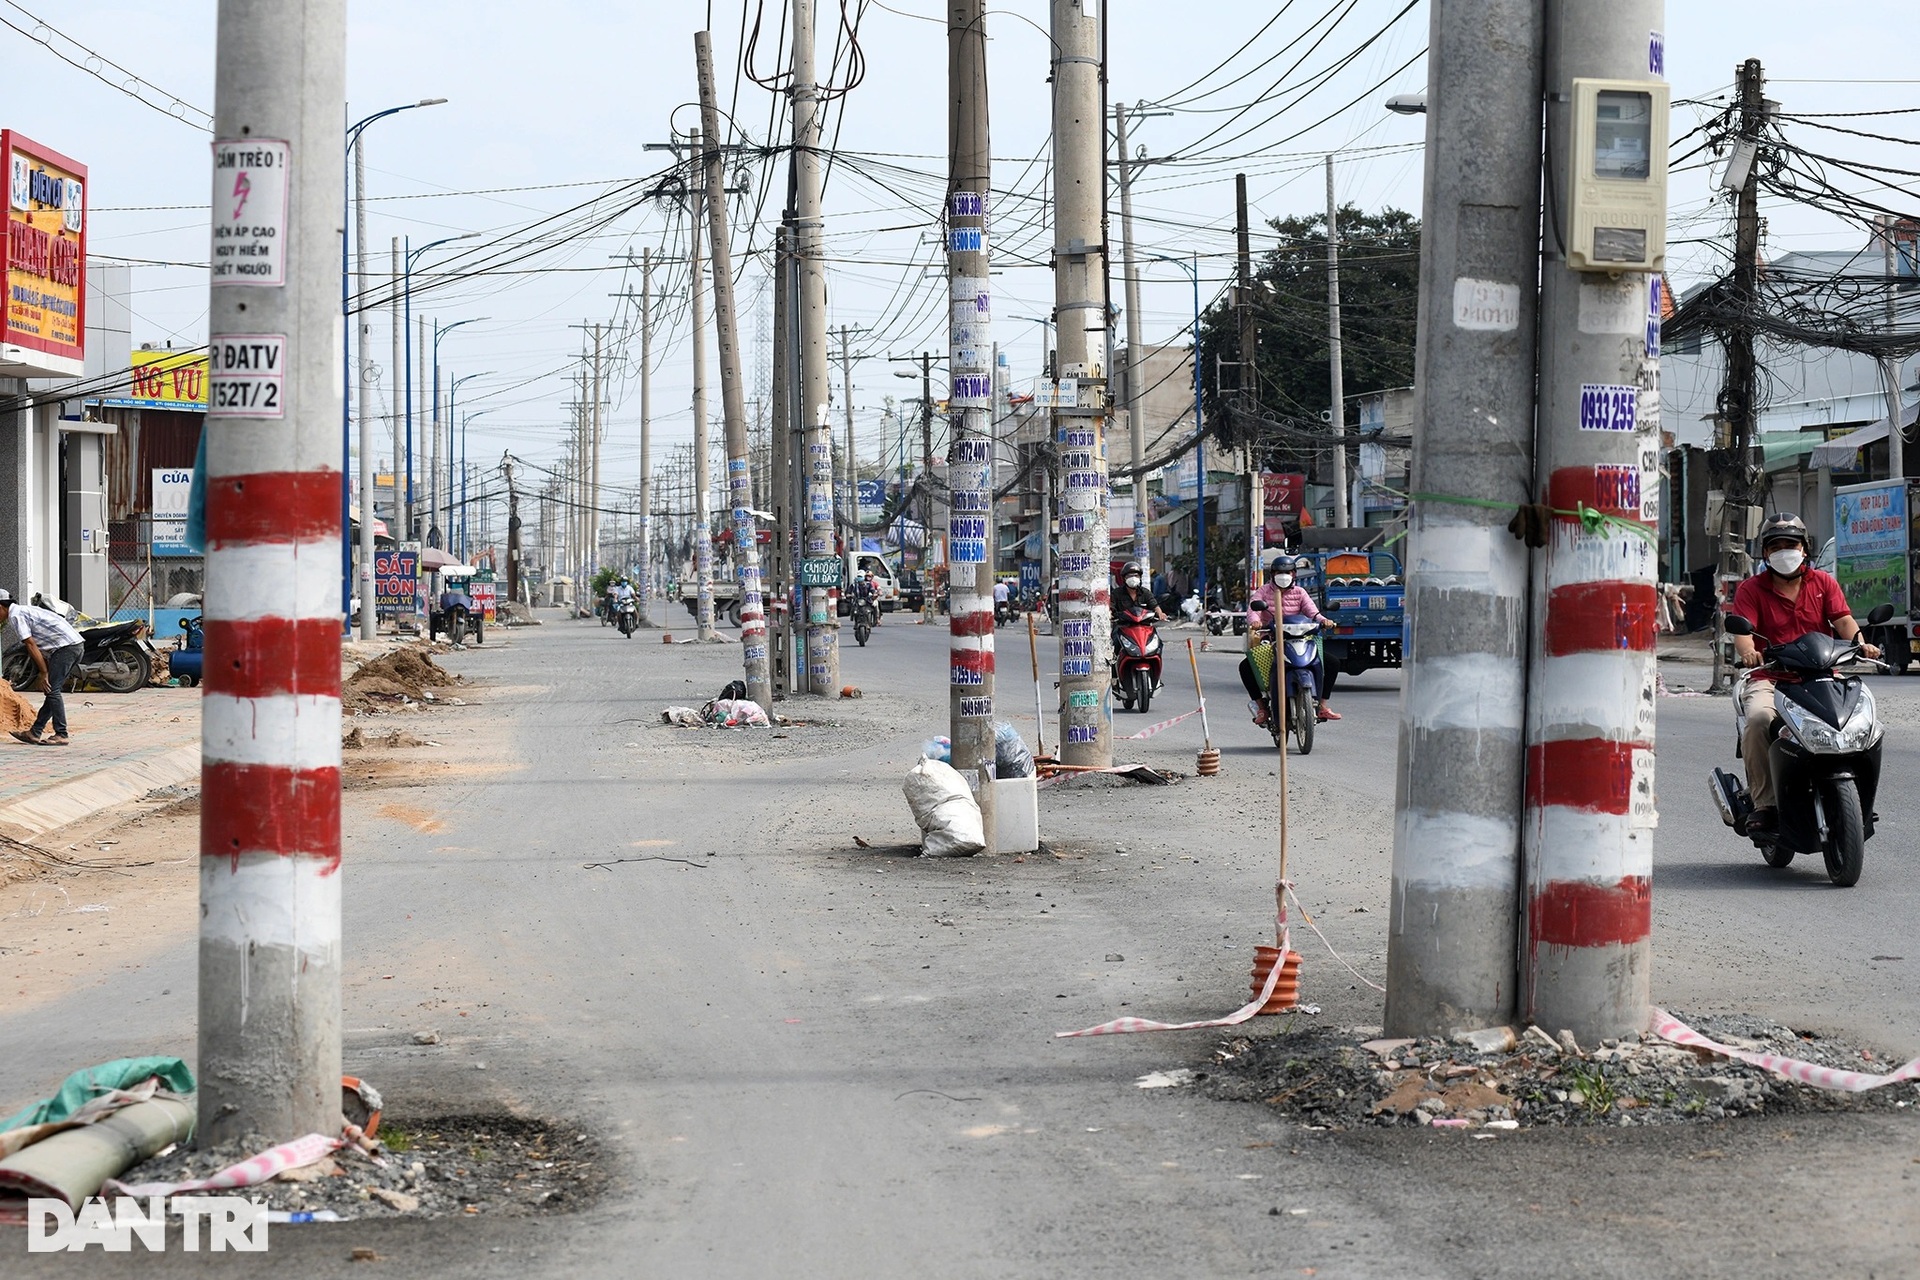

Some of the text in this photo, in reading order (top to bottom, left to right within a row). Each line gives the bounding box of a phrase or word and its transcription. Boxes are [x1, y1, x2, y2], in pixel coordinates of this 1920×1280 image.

[239, 146, 274, 168] TRÈO
[234, 225, 249, 238] ÁP
[252, 226, 276, 237] CAO
[225, 344, 279, 369] ĐATV
[172, 360, 202, 401] VŨ
[376, 552, 414, 576] SẮT
[1022, 563, 1040, 581] TÔN
[376, 575, 416, 596] TÔN
